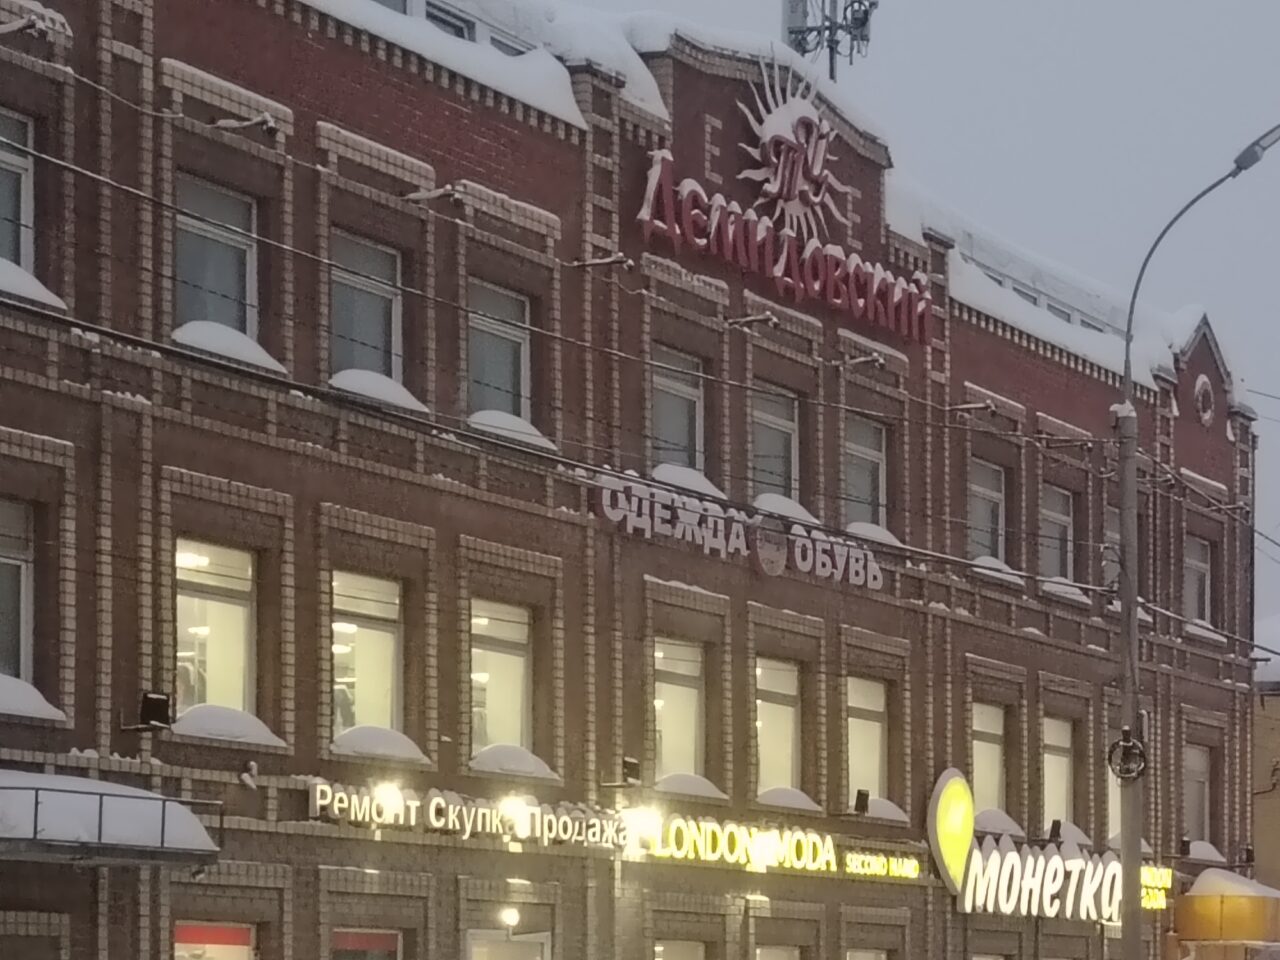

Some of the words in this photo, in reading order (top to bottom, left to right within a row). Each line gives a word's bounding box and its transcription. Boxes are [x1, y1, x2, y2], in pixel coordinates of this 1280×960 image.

[601, 481, 750, 558] ОДЕЖДА
[793, 529, 883, 590] ОБУВЬ
[315, 784, 420, 826] Ремонт
[656, 816, 760, 864] LONDON
[770, 829, 838, 872] MODA
